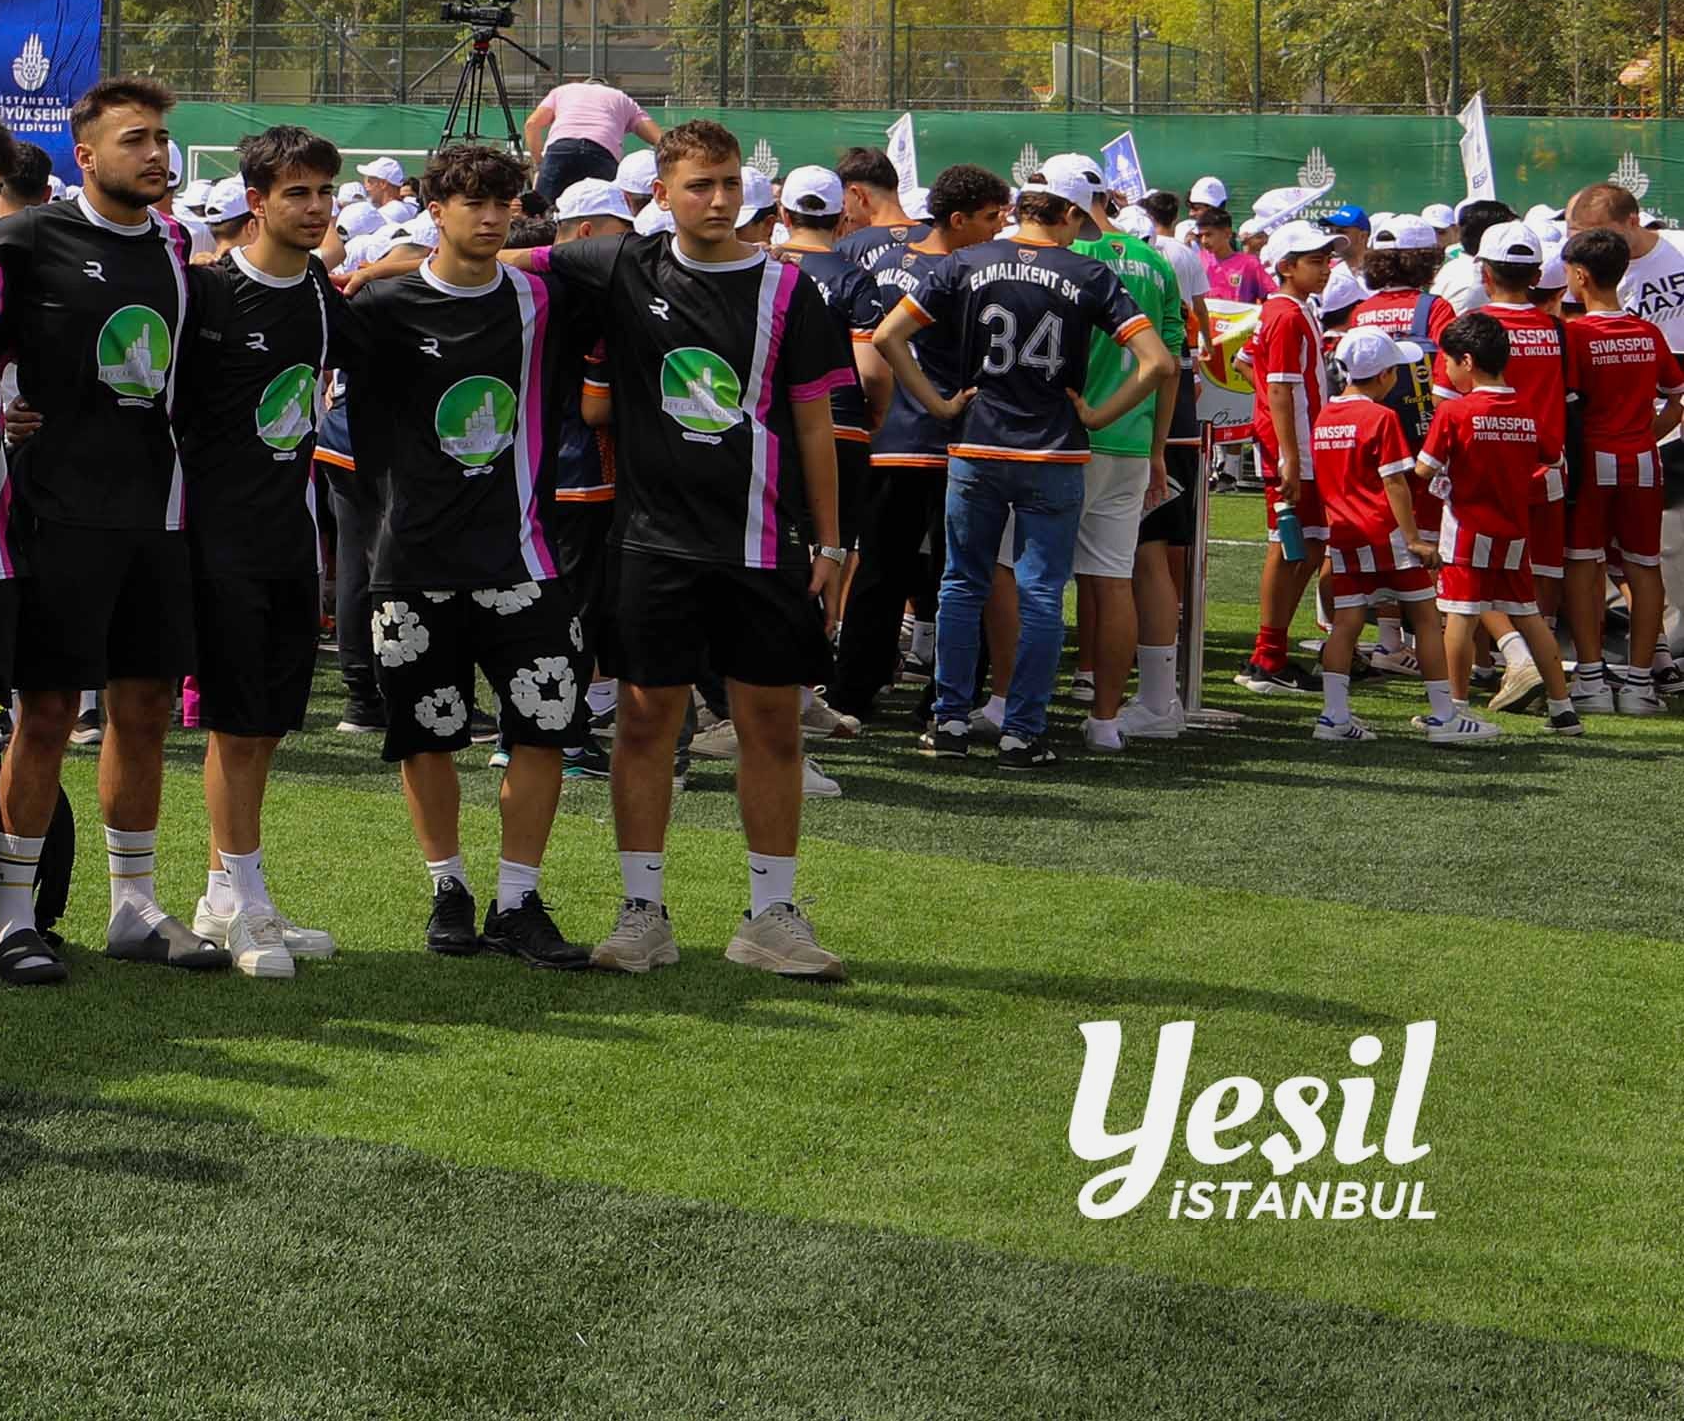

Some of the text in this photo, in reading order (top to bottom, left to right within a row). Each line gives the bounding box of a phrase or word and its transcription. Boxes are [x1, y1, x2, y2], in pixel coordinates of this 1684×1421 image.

[0, 94, 62, 105] İSTANBUL
[970, 262, 1081, 305] ELMALIKENT SK
[978, 303, 1065, 381] 34
[1592, 354, 1621, 365] FUTBOL
